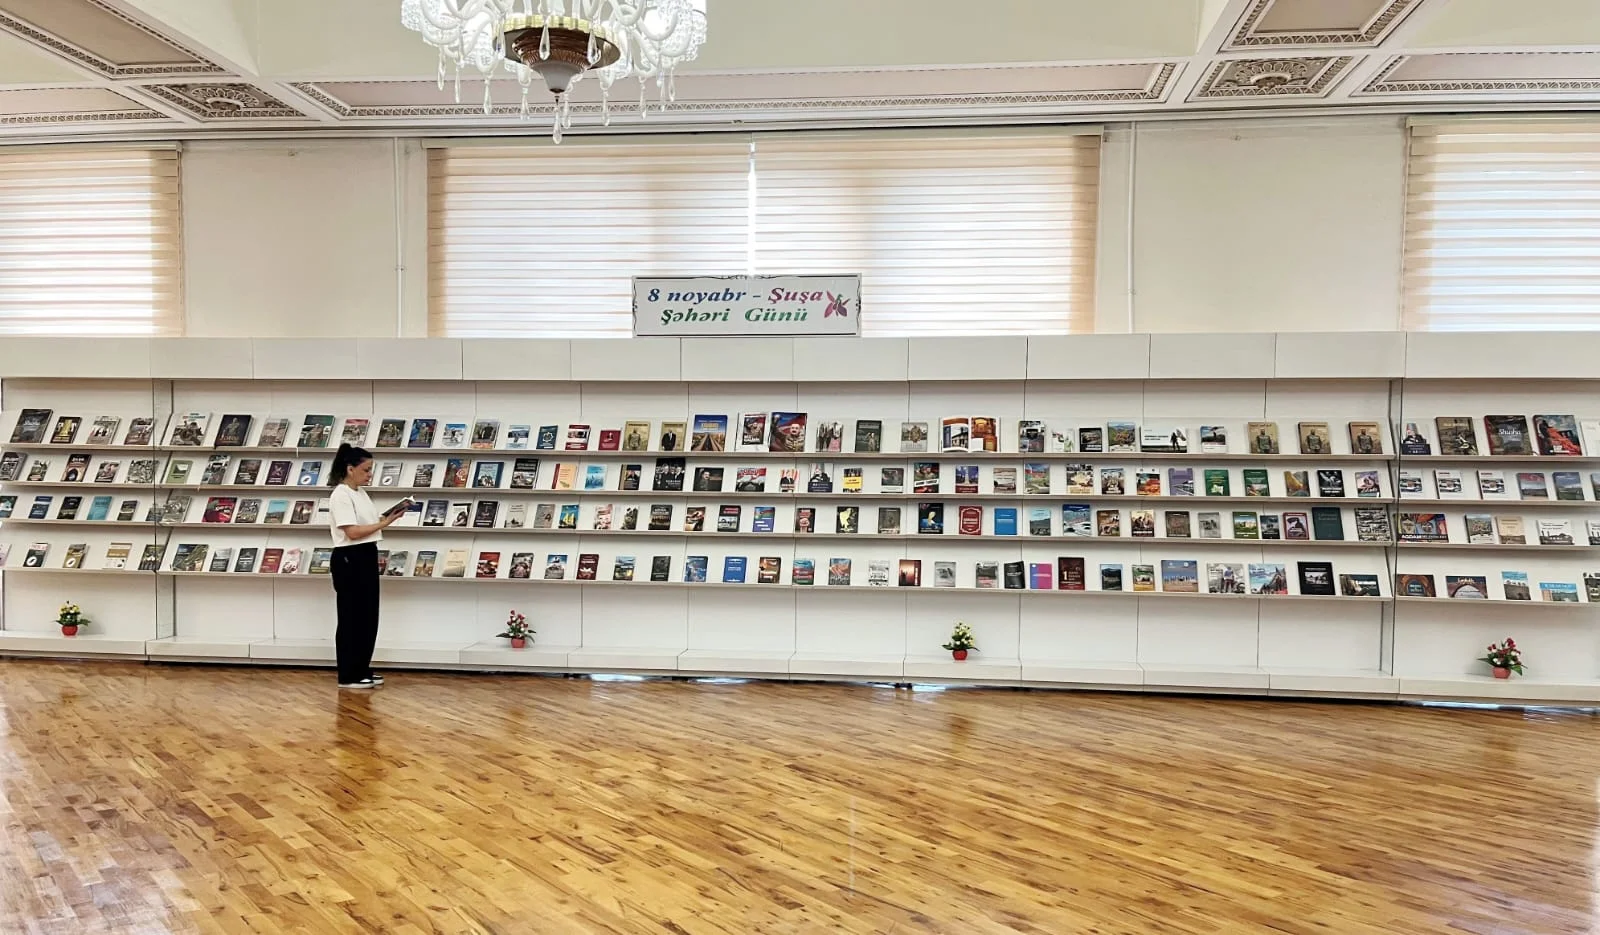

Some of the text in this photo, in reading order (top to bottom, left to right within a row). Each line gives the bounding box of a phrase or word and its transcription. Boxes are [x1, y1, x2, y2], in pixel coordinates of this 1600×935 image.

[647, 288, 660, 302] 8
[667, 288, 747, 304] noyabr
[768, 287, 823, 304] Şuşa
[661, 308, 808, 325] Şəhəri Günü
